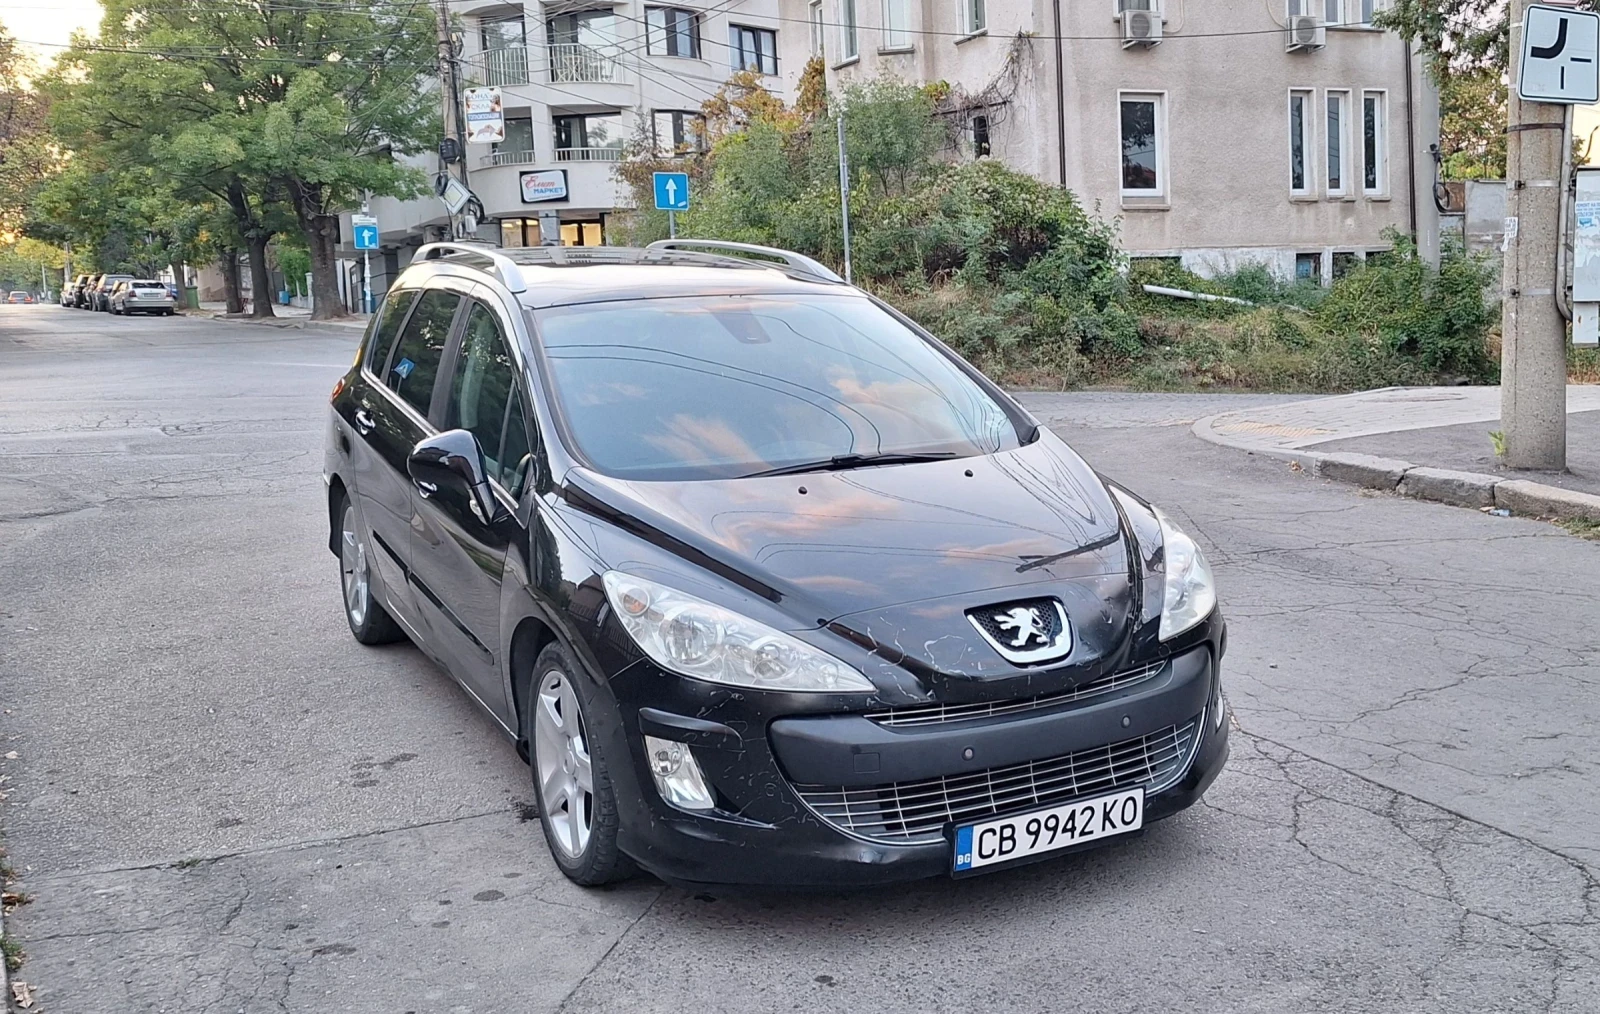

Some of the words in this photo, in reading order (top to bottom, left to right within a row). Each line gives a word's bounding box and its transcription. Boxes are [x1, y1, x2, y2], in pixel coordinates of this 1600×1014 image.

[978, 823, 1017, 860] CB
[1025, 806, 1095, 850] 9942
[1101, 796, 1138, 832] KO
[957, 853, 971, 865] BG
